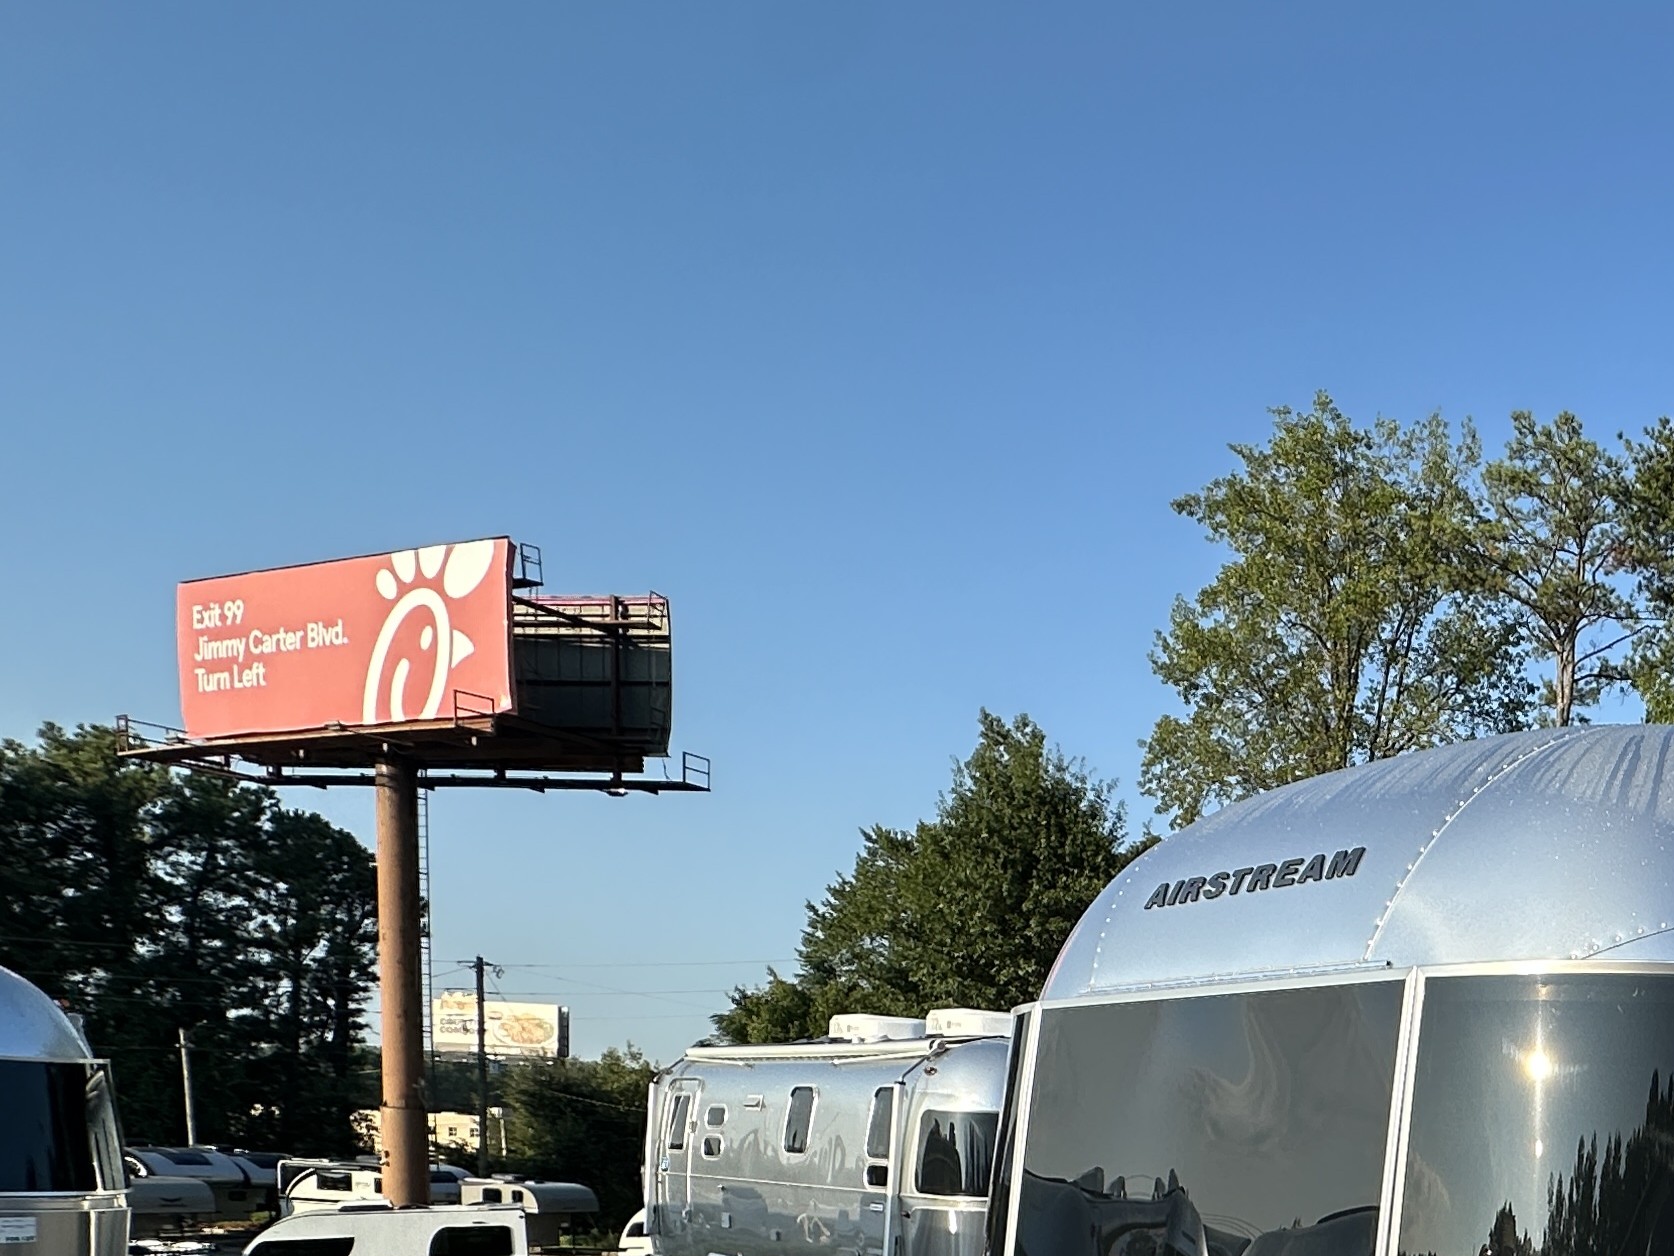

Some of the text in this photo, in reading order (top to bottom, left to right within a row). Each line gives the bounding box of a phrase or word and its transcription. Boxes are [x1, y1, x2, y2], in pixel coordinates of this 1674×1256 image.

[192, 599, 244, 629] Exit 99
[194, 618, 349, 662] Jimmy Carter Blvd.
[194, 662, 266, 692] Turn Left
[1144, 846, 1367, 910] AIRSTREAM
